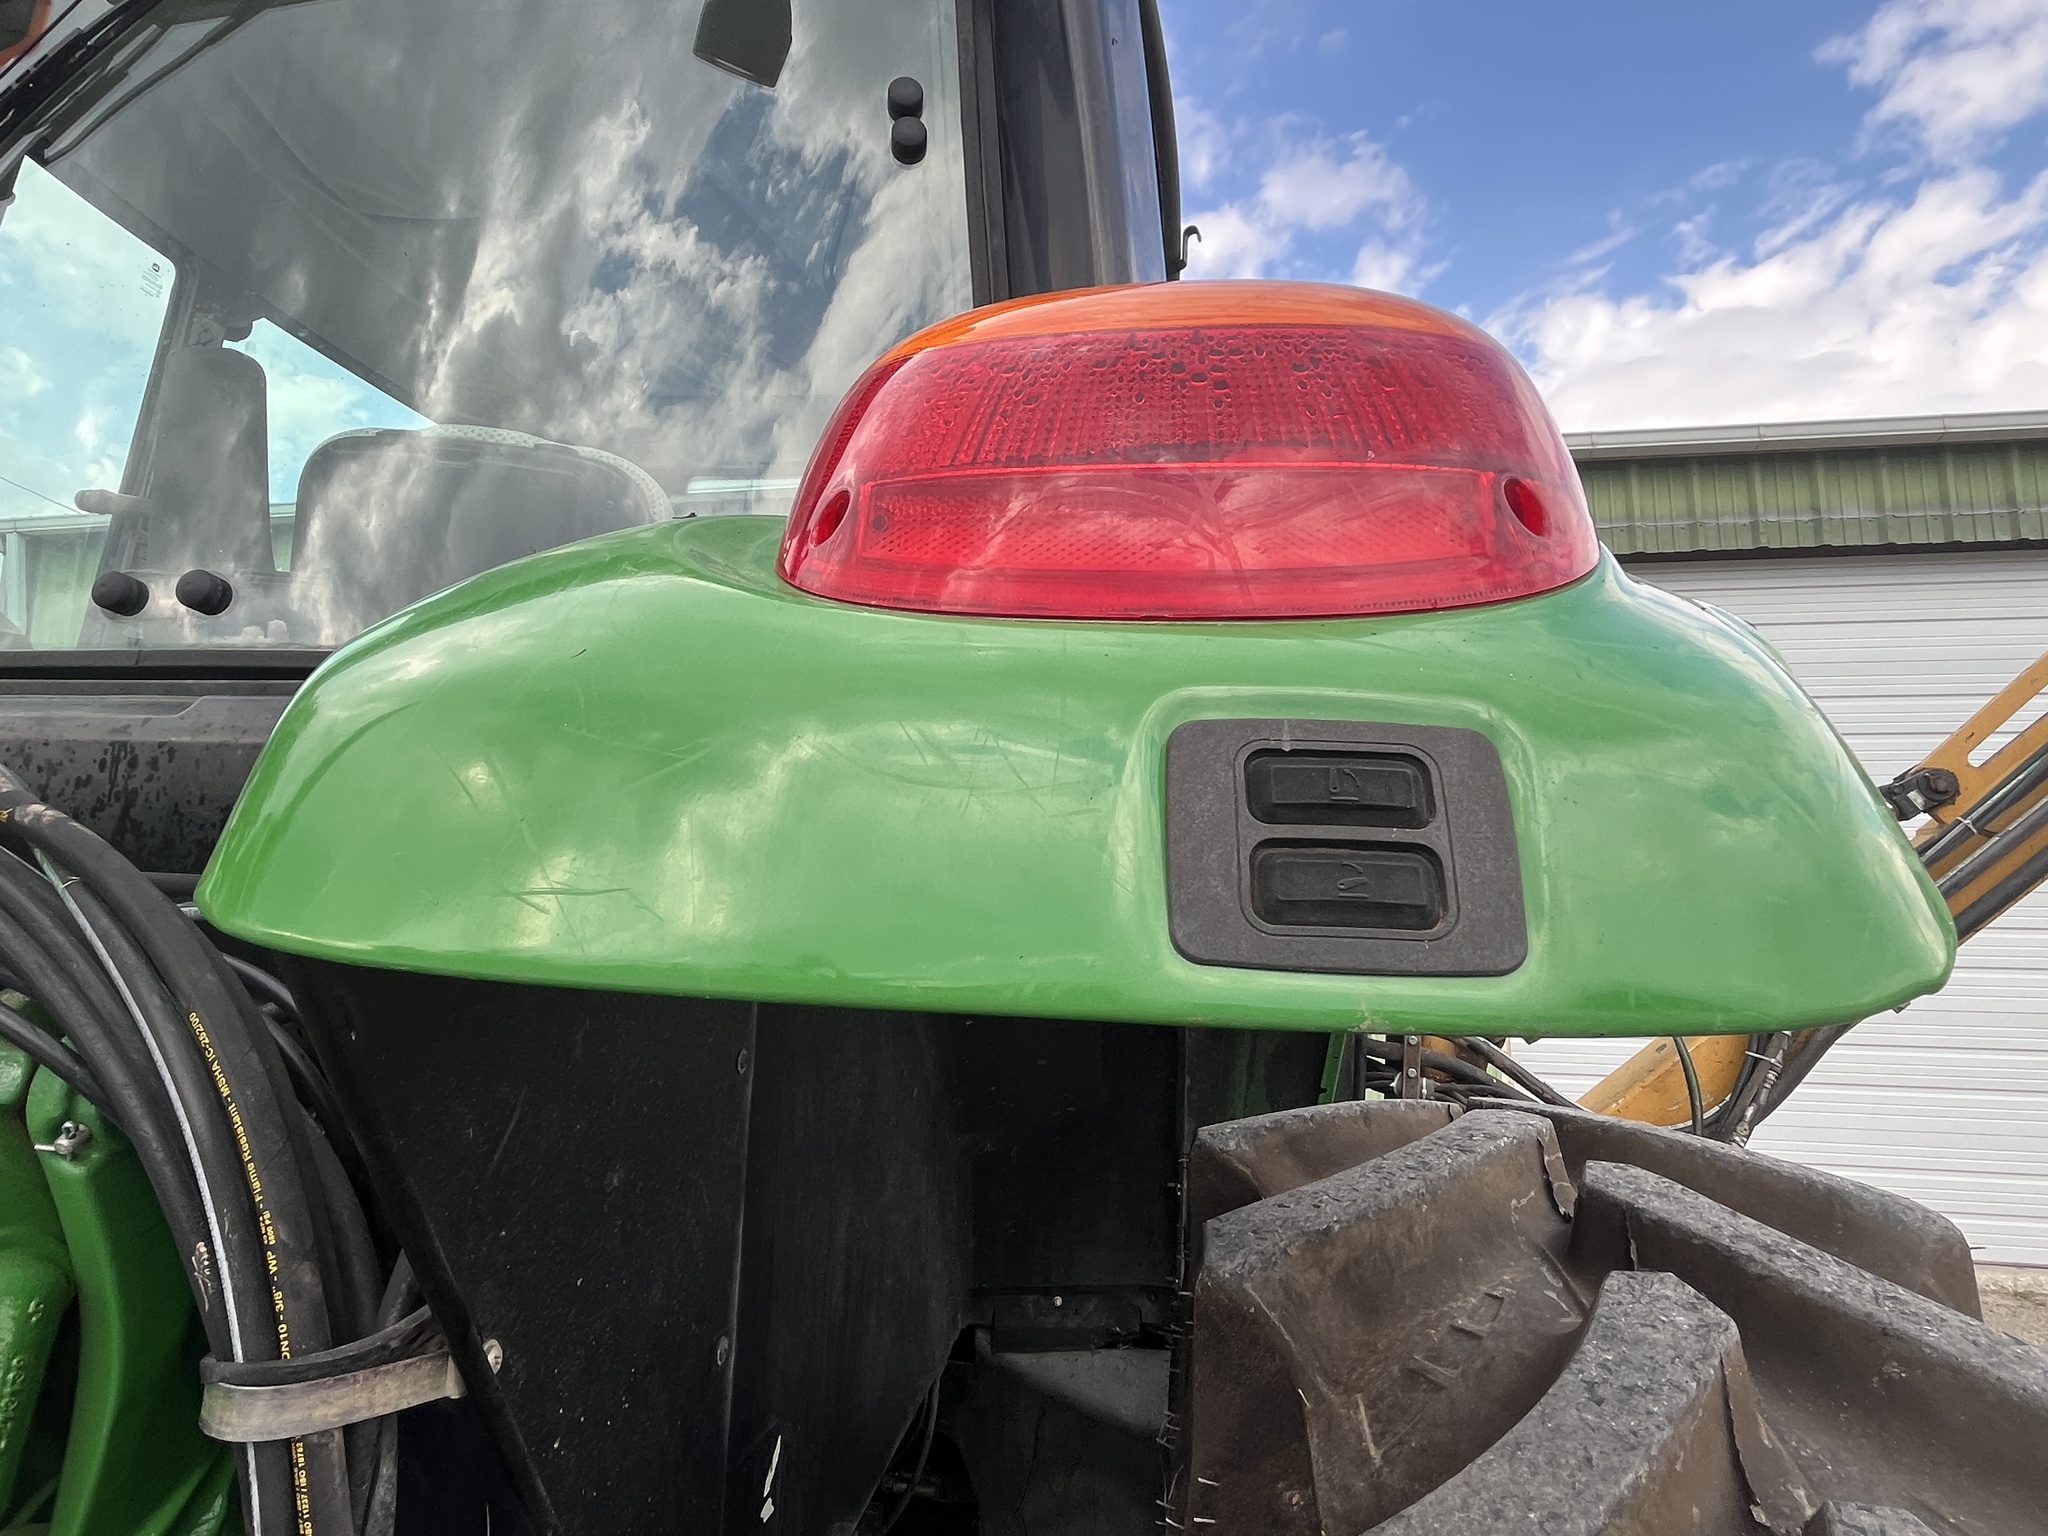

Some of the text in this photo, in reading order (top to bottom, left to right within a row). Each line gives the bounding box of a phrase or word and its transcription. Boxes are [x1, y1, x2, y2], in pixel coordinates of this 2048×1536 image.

[211, 1060, 231, 1098] MSHA
[227, 1102, 252, 1161] Resistant
[247, 1162, 263, 1202] Flame
[267, 1251, 278, 1275] WP
